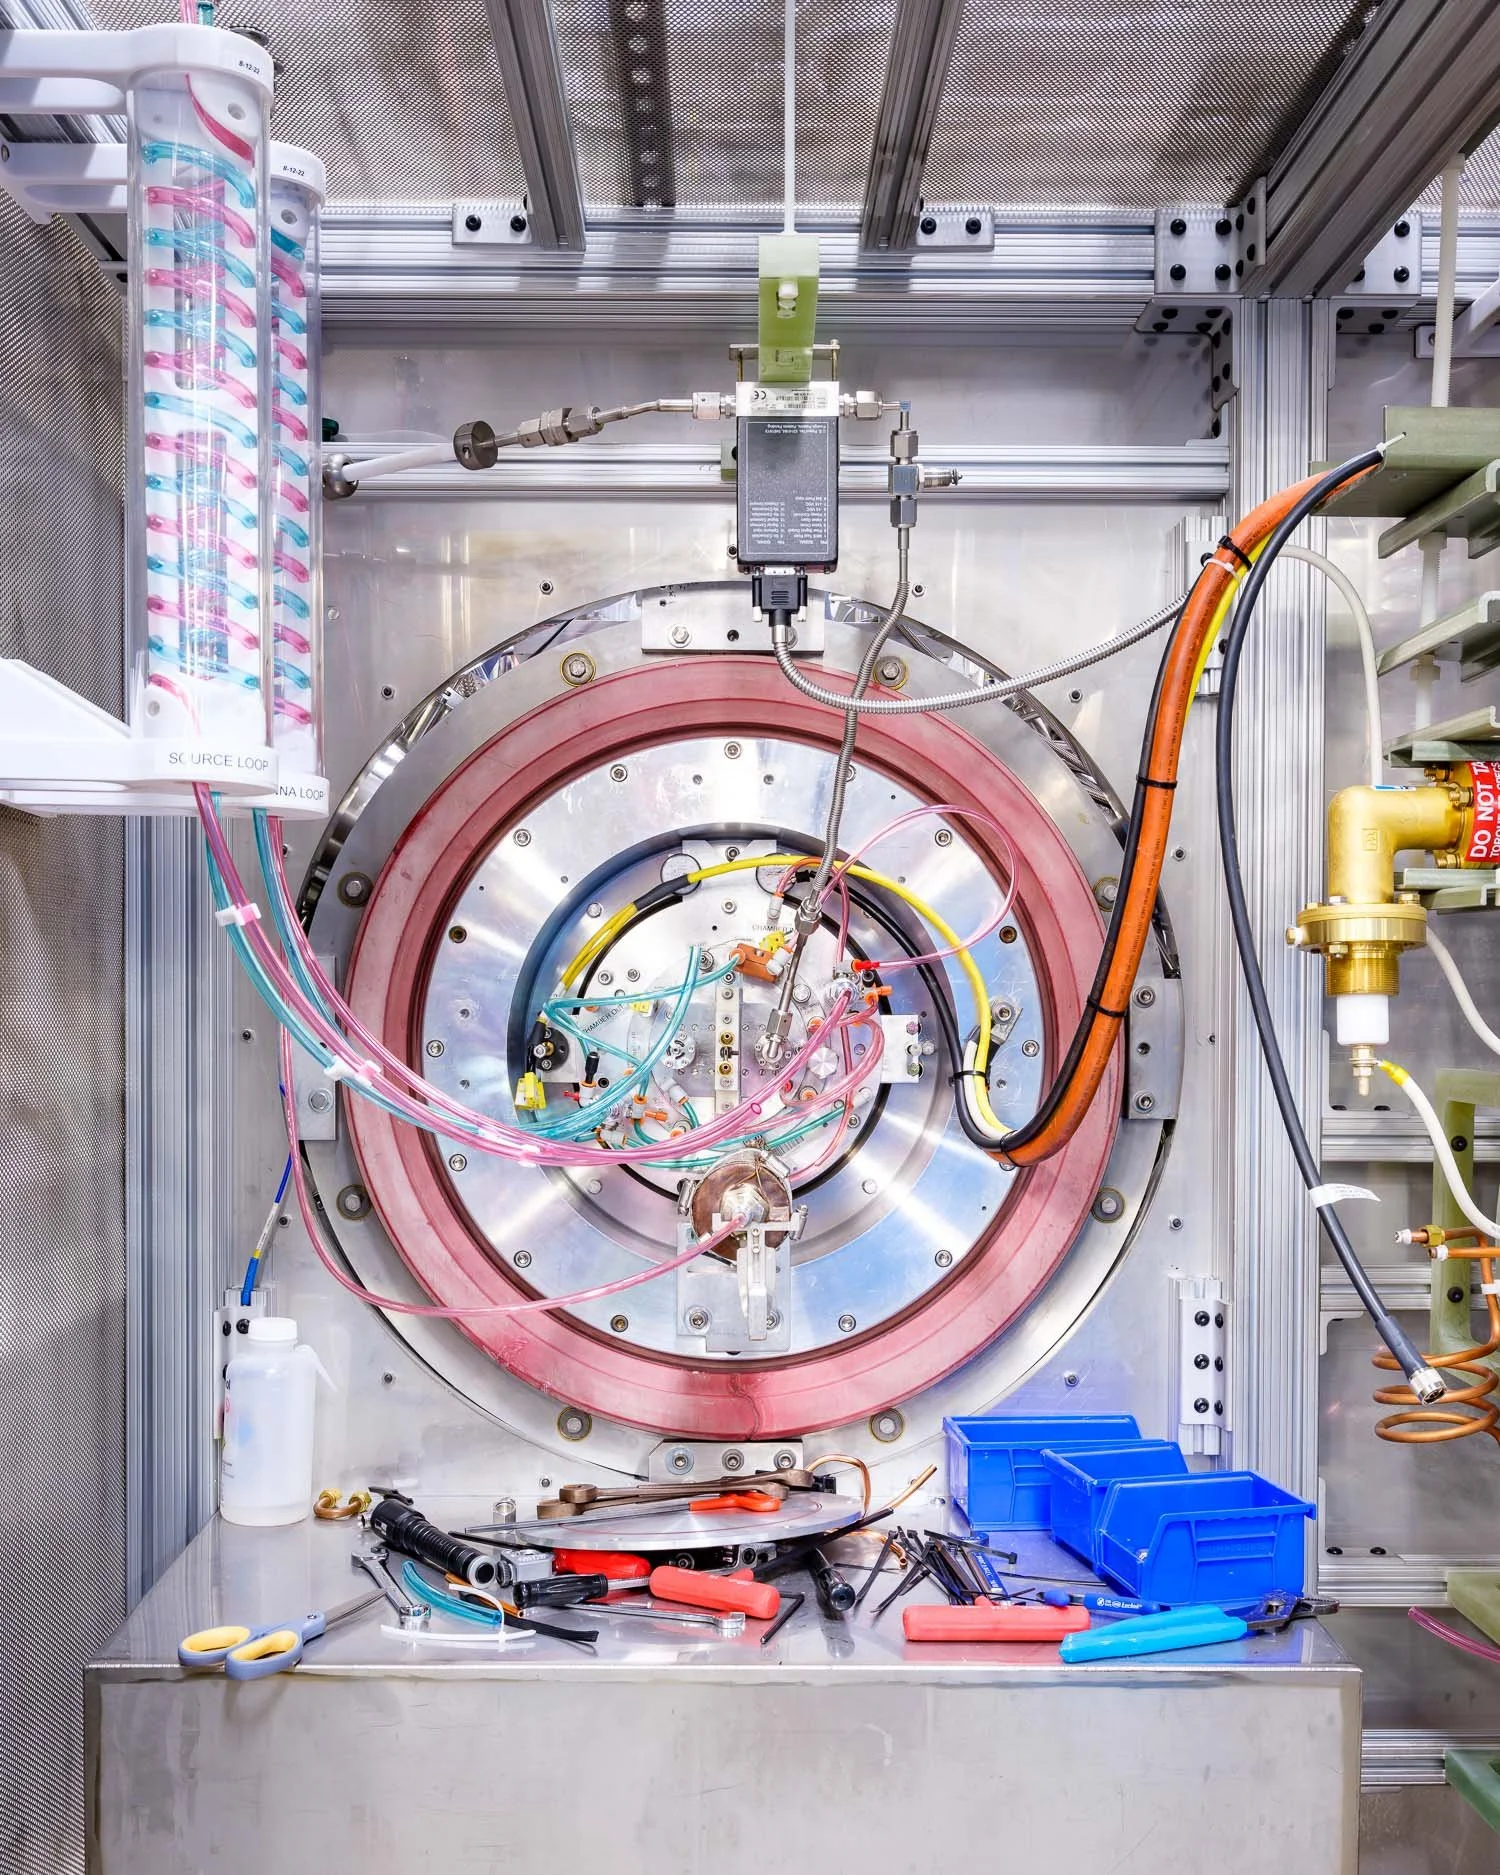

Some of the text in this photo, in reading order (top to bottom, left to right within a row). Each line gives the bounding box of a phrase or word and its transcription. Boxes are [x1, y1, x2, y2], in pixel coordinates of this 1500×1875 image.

[238, 60, 260, 74] 8-12-22
[282, 165, 305, 176] 8-12-22
[237, 757, 269, 771] LOOP
[275, 785, 324, 801] NA LOOP
[1476, 780, 1495, 821] NOT
[1469, 829, 1492, 858] DO
[583, 1013, 612, 1034] HAMBER
